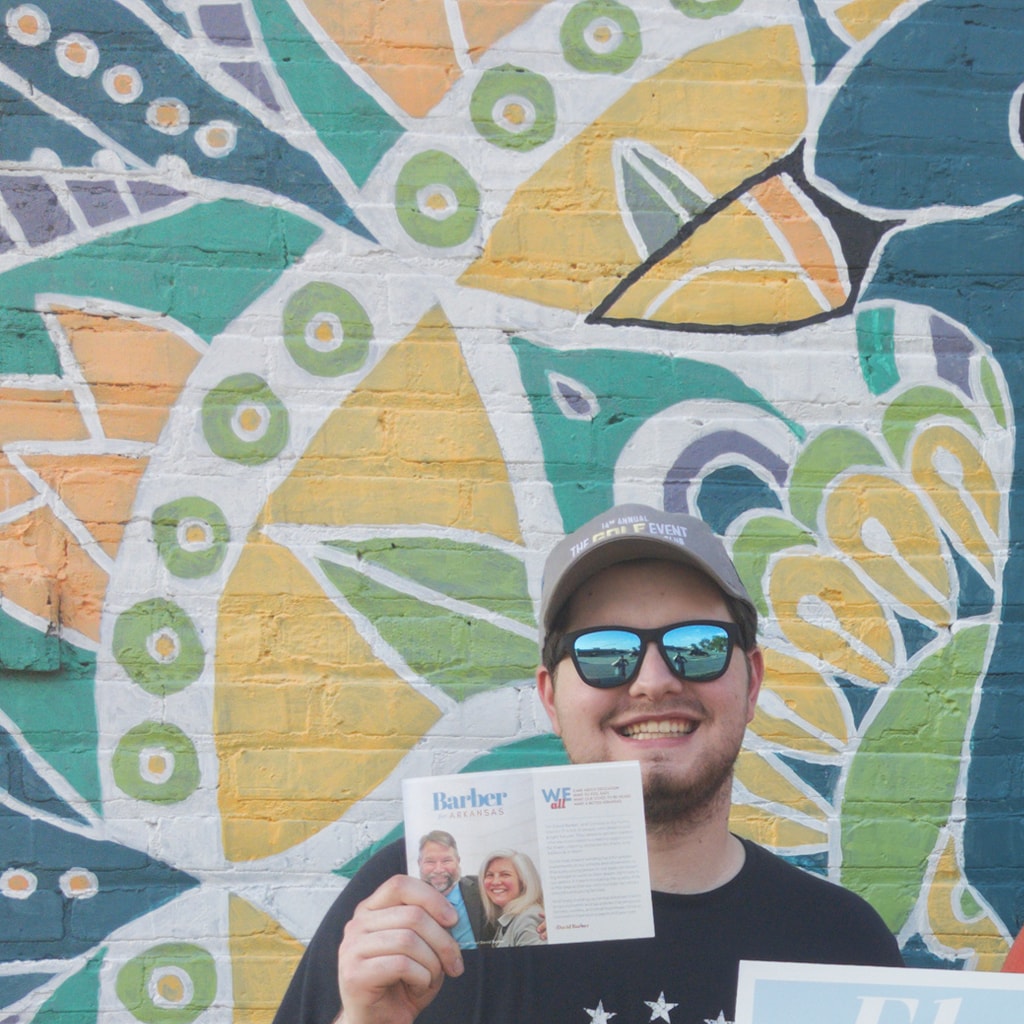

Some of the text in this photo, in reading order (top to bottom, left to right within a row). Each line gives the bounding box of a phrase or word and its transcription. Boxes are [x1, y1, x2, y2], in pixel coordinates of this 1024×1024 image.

[617, 514, 649, 526] ANNUAL
[569, 538, 590, 557] THE
[648, 522, 688, 538] EVENT
[432, 787, 508, 811] Barber
[541, 786, 572, 803] WE
[550, 797, 566, 810] all
[449, 807, 505, 820] ARKANSAS
